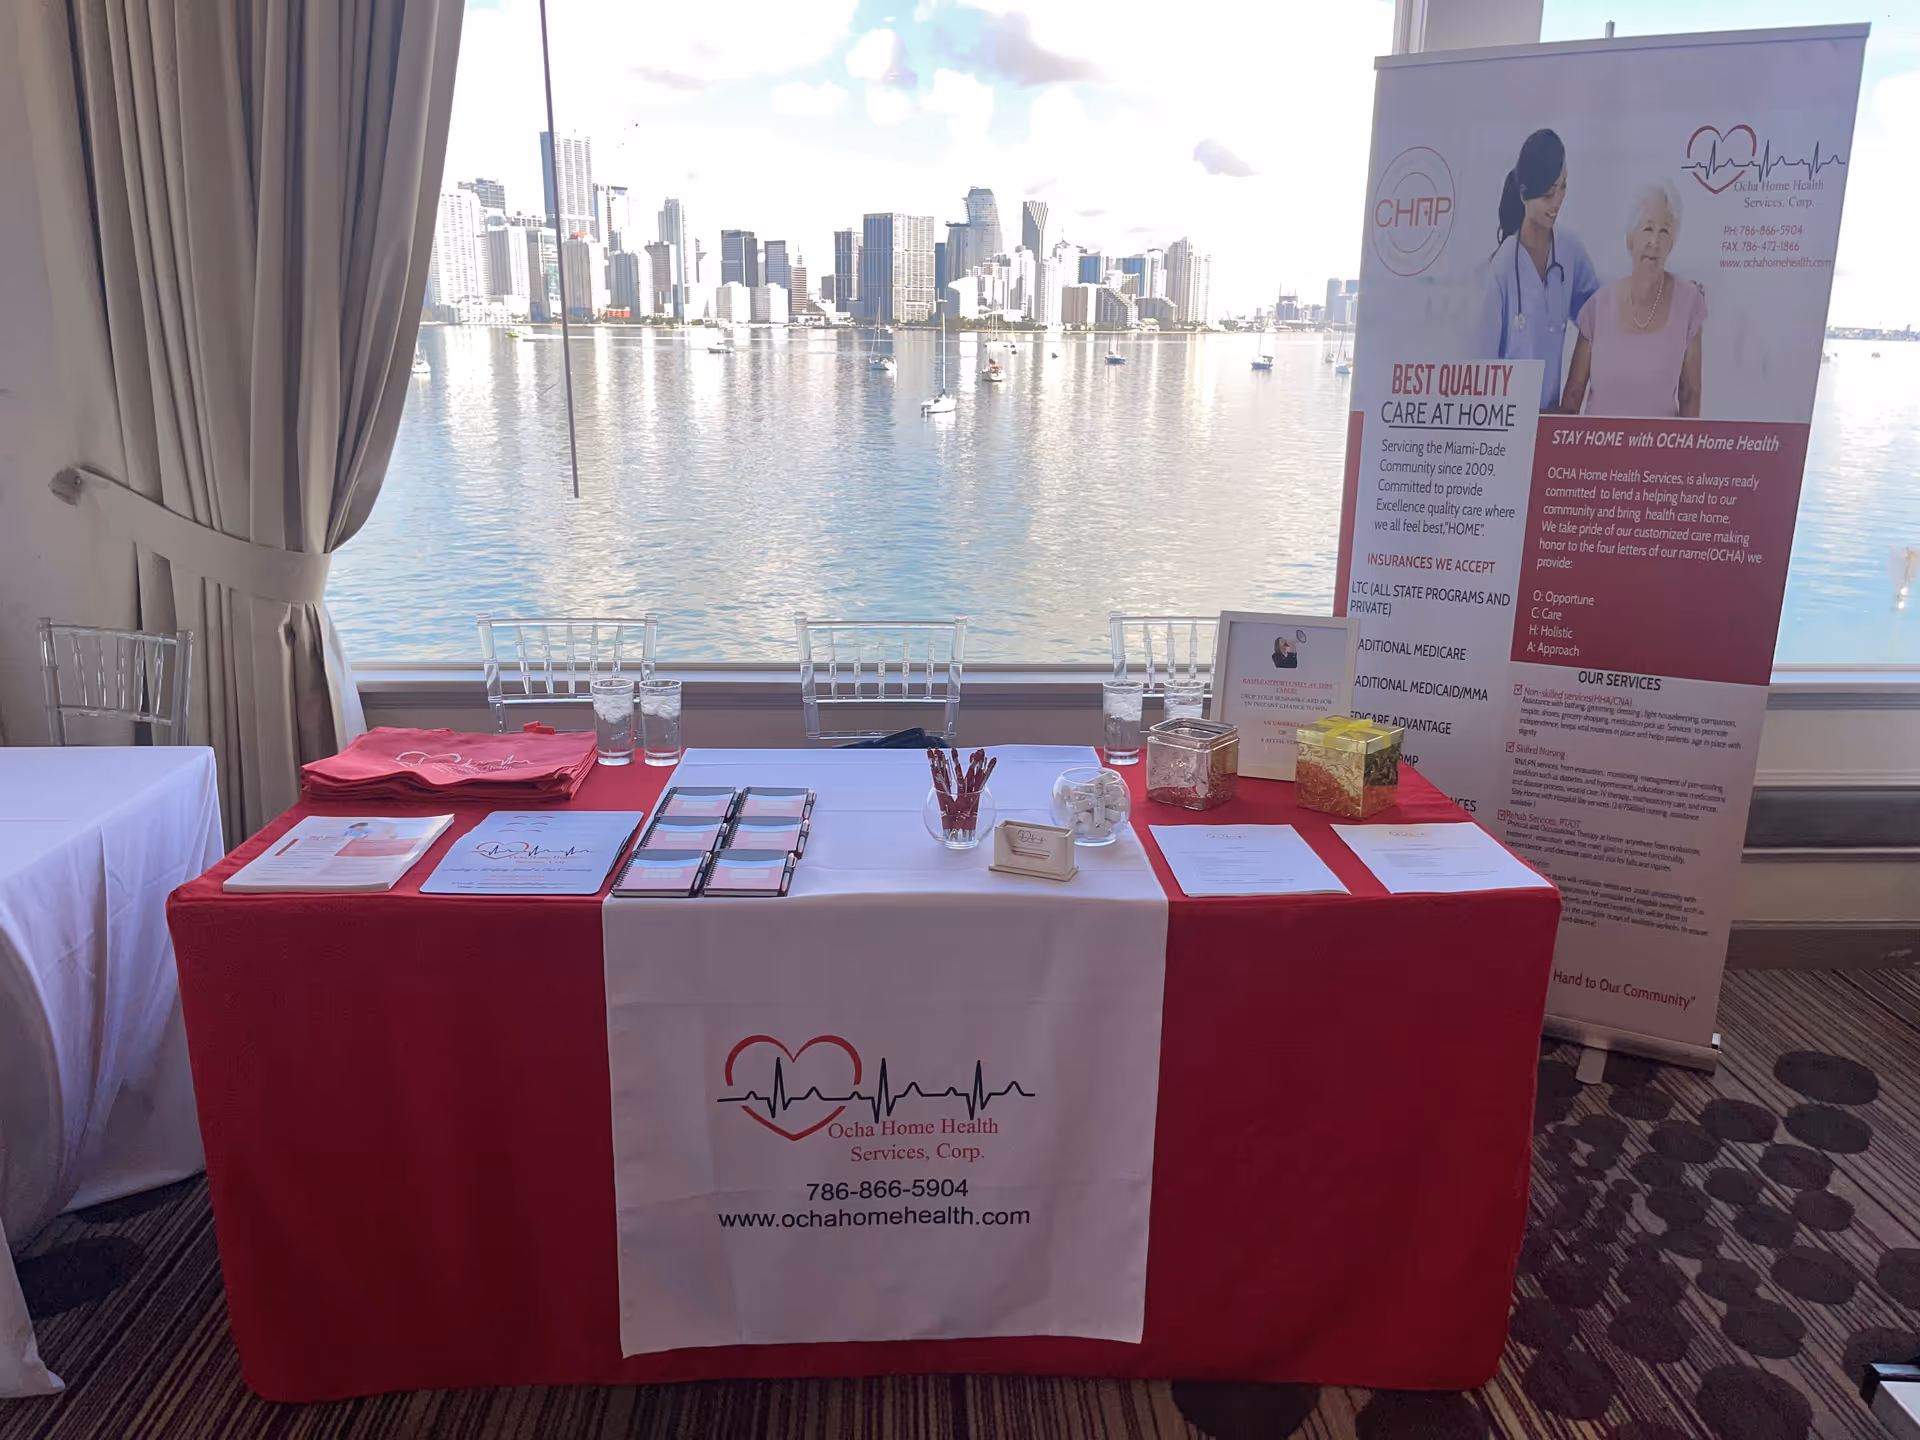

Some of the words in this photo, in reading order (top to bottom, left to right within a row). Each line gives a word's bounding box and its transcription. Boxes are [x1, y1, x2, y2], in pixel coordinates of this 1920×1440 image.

[1734, 181, 1758, 192] Ocha
[1762, 180, 1790, 191] Home
[1793, 180, 1823, 190] Health
[1789, 197, 1814, 209] Corp.
[1740, 225, 1802, 236] 786-866-5904
[1742, 241, 1799, 251] 786-472-1866
[1392, 364, 1435, 394] BEST
[1439, 364, 1513, 397] QUALITY
[1381, 401, 1427, 424] CARE
[1431, 403, 1454, 425] AT
[1458, 404, 1516, 426] HOME
[1382, 439, 1424, 457] Servicing
[1427, 440, 1442, 453] the
[1445, 442, 1506, 456] Miami-Dade
[1552, 429, 1583, 445] STAY
[1584, 432, 1624, 446] HOME
[1628, 432, 1654, 448] with
[1656, 433, 1694, 449] OCHA
[1696, 435, 1734, 450] Home
[1737, 435, 1780, 452] Health
[1380, 459, 1435, 477] Community
[1438, 462, 1462, 475] since
[1465, 462, 1496, 476] 2009.
[1378, 479, 1431, 493] Committed
[1434, 482, 1444, 494] to
[1446, 483, 1482, 497] provide
[1548, 467, 1577, 480] OCHA
[1579, 468, 1607, 481] Home
[1610, 470, 1640, 483] Health
[1687, 472, 1694, 485] is
[1696, 473, 1729, 489] always
[1732, 474, 1760, 491] ready
[1545, 486, 1596, 499] committed
[1600, 488, 1610, 499] to
[1612, 488, 1633, 500] lend
[1635, 492, 1640, 501] a
[1642, 489, 1677, 506] helping
[1680, 491, 1705, 504] hand
[1708, 493, 1718, 505] to
[1720, 496, 1737, 505] our
[1376, 498, 1425, 512] Excellence
[1428, 501, 1460, 518] quality
[1462, 506, 1482, 516] care
[1485, 504, 1515, 518] where
[1543, 504, 1595, 519] community
[1597, 505, 1615, 518] and
[1617, 506, 1641, 522] bring
[1646, 507, 1675, 521] health
[1678, 511, 1697, 522] care
[1700, 510, 1731, 524] home.
[1374, 521, 1387, 530] we
[1390, 519, 1400, 531] all
[1403, 519, 1420, 532] feel
[1541, 521, 1557, 533] We
[1559, 521, 1577, 534] take
[1579, 522, 1602, 537] pride
[1605, 524, 1615, 536] of
[1616, 527, 1632, 537] our
[1634, 525, 1689, 540] customized
[1691, 531, 1711, 541] care
[1714, 531, 1750, 547] making
[1539, 538, 1566, 550] honor
[1568, 541, 1578, 551] to
[1580, 540, 1594, 553] the
[1597, 541, 1616, 554] four
[1618, 542, 1647, 556] letters
[1649, 544, 1659, 556] of
[1661, 548, 1676, 558] our
[1679, 547, 1745, 563] name(OCHA)
[1748, 553, 1762, 563] we
[1368, 552, 1433, 569] INSURANCES
[1436, 558, 1452, 570] WE
[1454, 560, 1495, 574] ACCEPT
[1537, 556, 1572, 570] provide:
[1352, 581, 1368, 594] LTC
[1370, 582, 1391, 597] (ALL
[1393, 584, 1423, 599] STATE
[1426, 587, 1484, 604] PROGRAMS
[1486, 592, 1511, 606] AND
[1533, 590, 1543, 601] O:
[1545, 590, 1594, 606] Opportune
[1350, 600, 1392, 617] PRIVATE)
[1531, 607, 1540, 619] C:
[1542, 608, 1562, 620] Care
[1529, 624, 1539, 636] H:
[1541, 625, 1573, 639] Holistic
[1358, 638, 1411, 655] ADITIONAL
[1414, 644, 1467, 661] MEDICARE
[1527, 641, 1536, 652] A:
[1537, 642, 1579, 657] Approach
[1354, 675, 1408, 692] ADITIONAL
[1410, 681, 1488, 700] MEDICAID/MMA
[1578, 671, 1604, 685] OUR
[1606, 673, 1661, 691] SERVICES
[1524, 688, 1563, 699] Non-skilled
[1350, 711, 1390, 724] EDICARE
[1392, 717, 1452, 734] ADVANTAGE
[1516, 744, 1538, 754] Skilled
[1539, 747, 1565, 760] Nursing
[1553, 969, 1583, 987] Hand
[1585, 977, 1596, 989] to
[1600, 978, 1621, 993] Our
[1623, 983, 1695, 1011] Community"
[828, 1123, 874, 1139] Ocha
[880, 1120, 935, 1137] Home
[940, 1118, 998, 1134] Health
[851, 1144, 930, 1163] Services,
[936, 1143, 985, 1162] Corp.
[806, 1178, 969, 1201] 786-866-5904
[718, 1206, 1030, 1228] www.ochahomehealth.com
